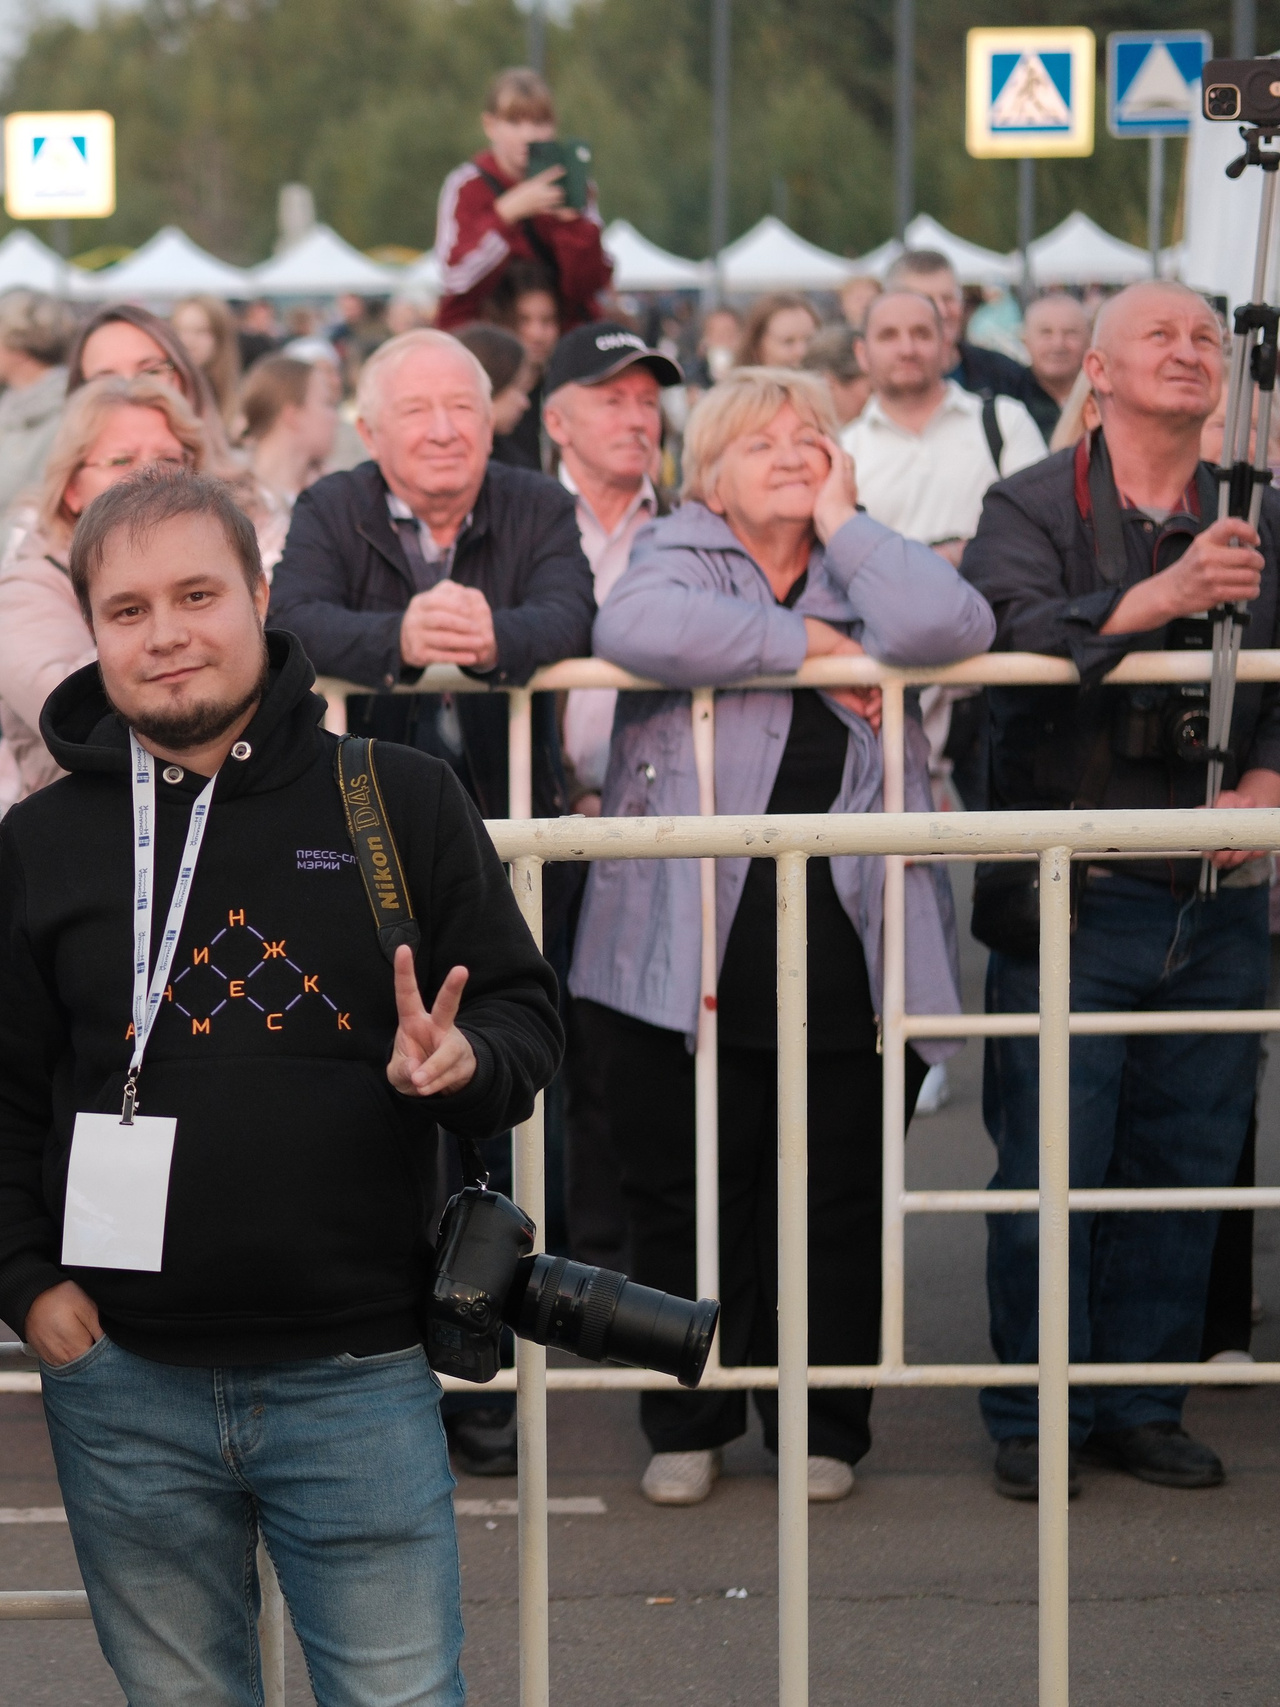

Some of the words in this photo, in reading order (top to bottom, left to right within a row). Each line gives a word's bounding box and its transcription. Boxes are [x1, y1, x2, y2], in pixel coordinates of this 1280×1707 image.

[296, 849, 357, 865] ПРЕСС-СЛ
[296, 860, 340, 871] МЭРИИ
[365, 836, 400, 910] Nikon
[193, 946, 210, 966] И
[262, 939, 287, 960] Ж
